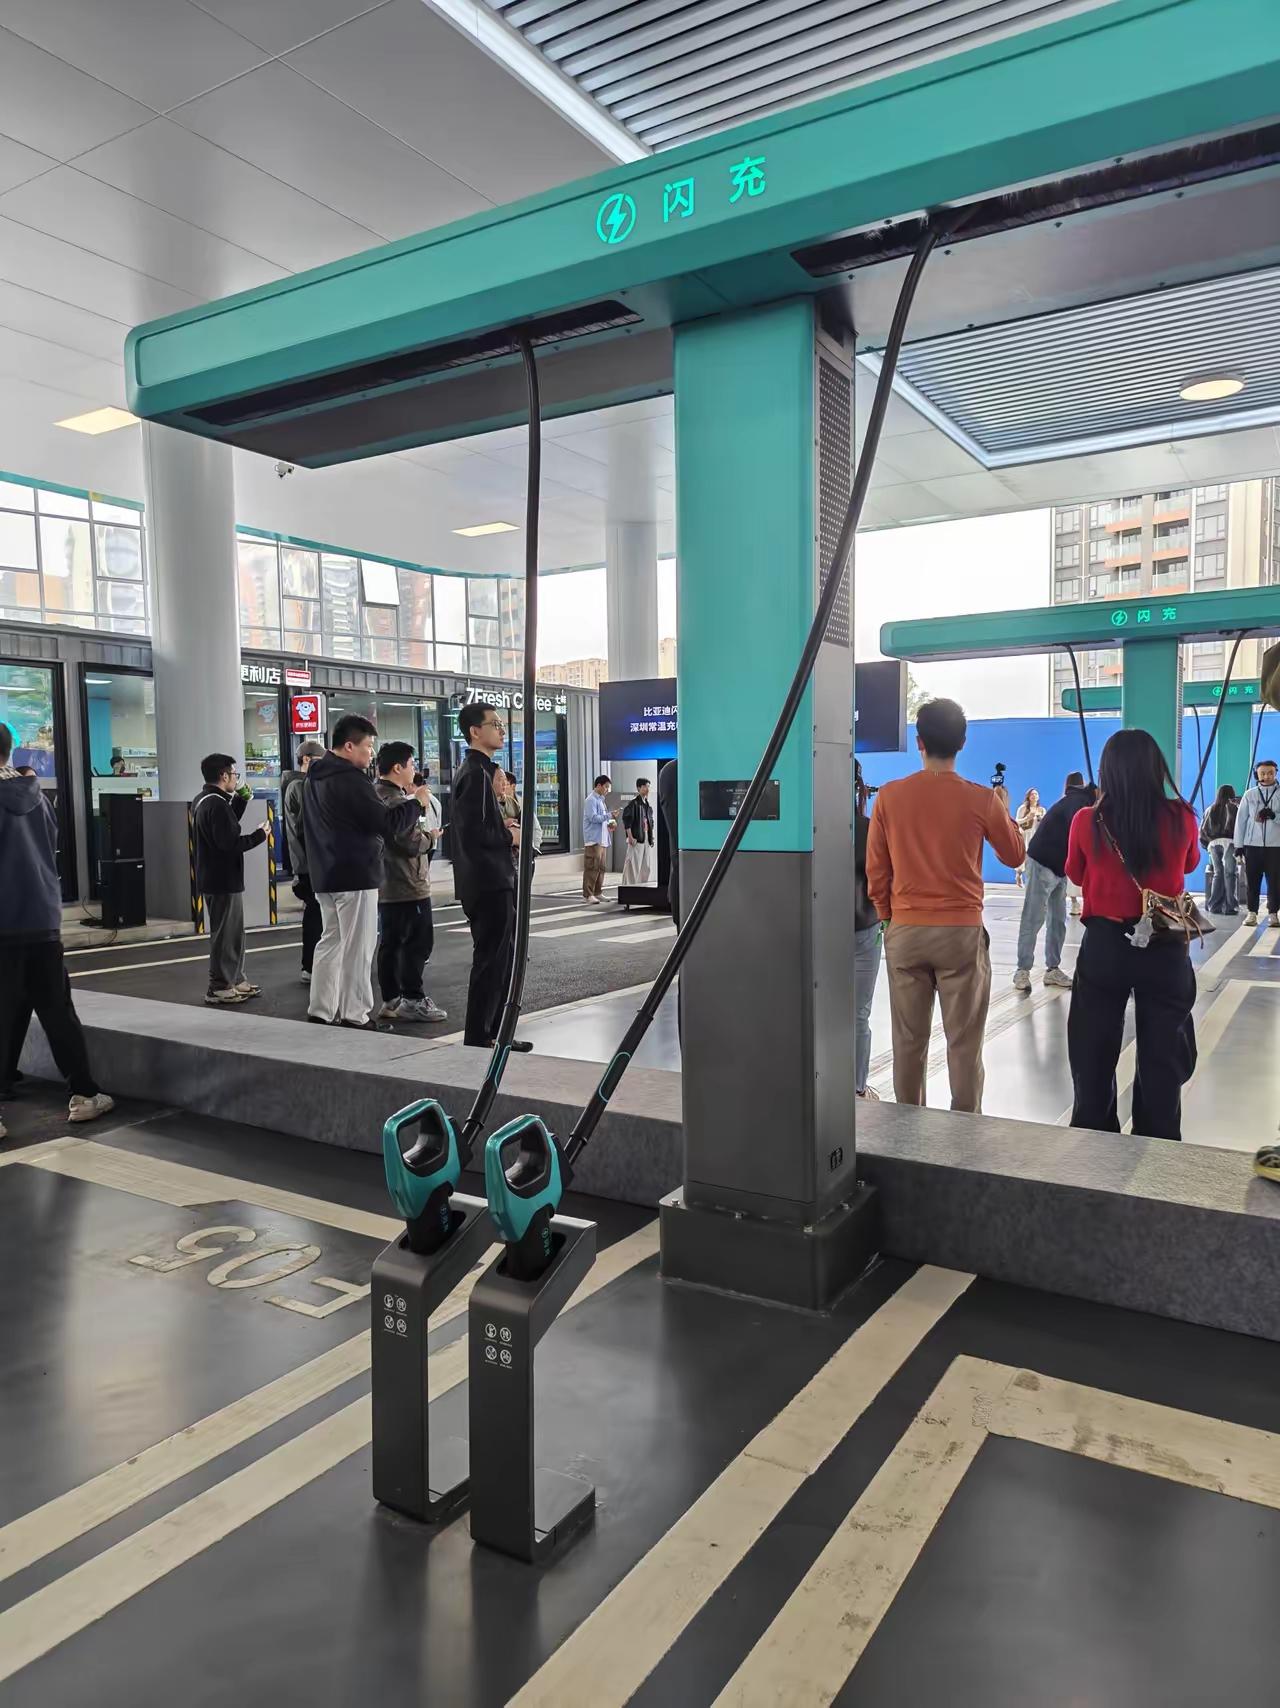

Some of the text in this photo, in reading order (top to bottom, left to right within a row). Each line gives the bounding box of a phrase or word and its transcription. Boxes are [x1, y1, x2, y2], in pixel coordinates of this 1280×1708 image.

[663, 156, 766, 223] 闪充
[1137, 607, 1176, 623] 闪充
[466, 687, 510, 709] 7Fresh
[629, 721, 679, 733] 深圳常温充
